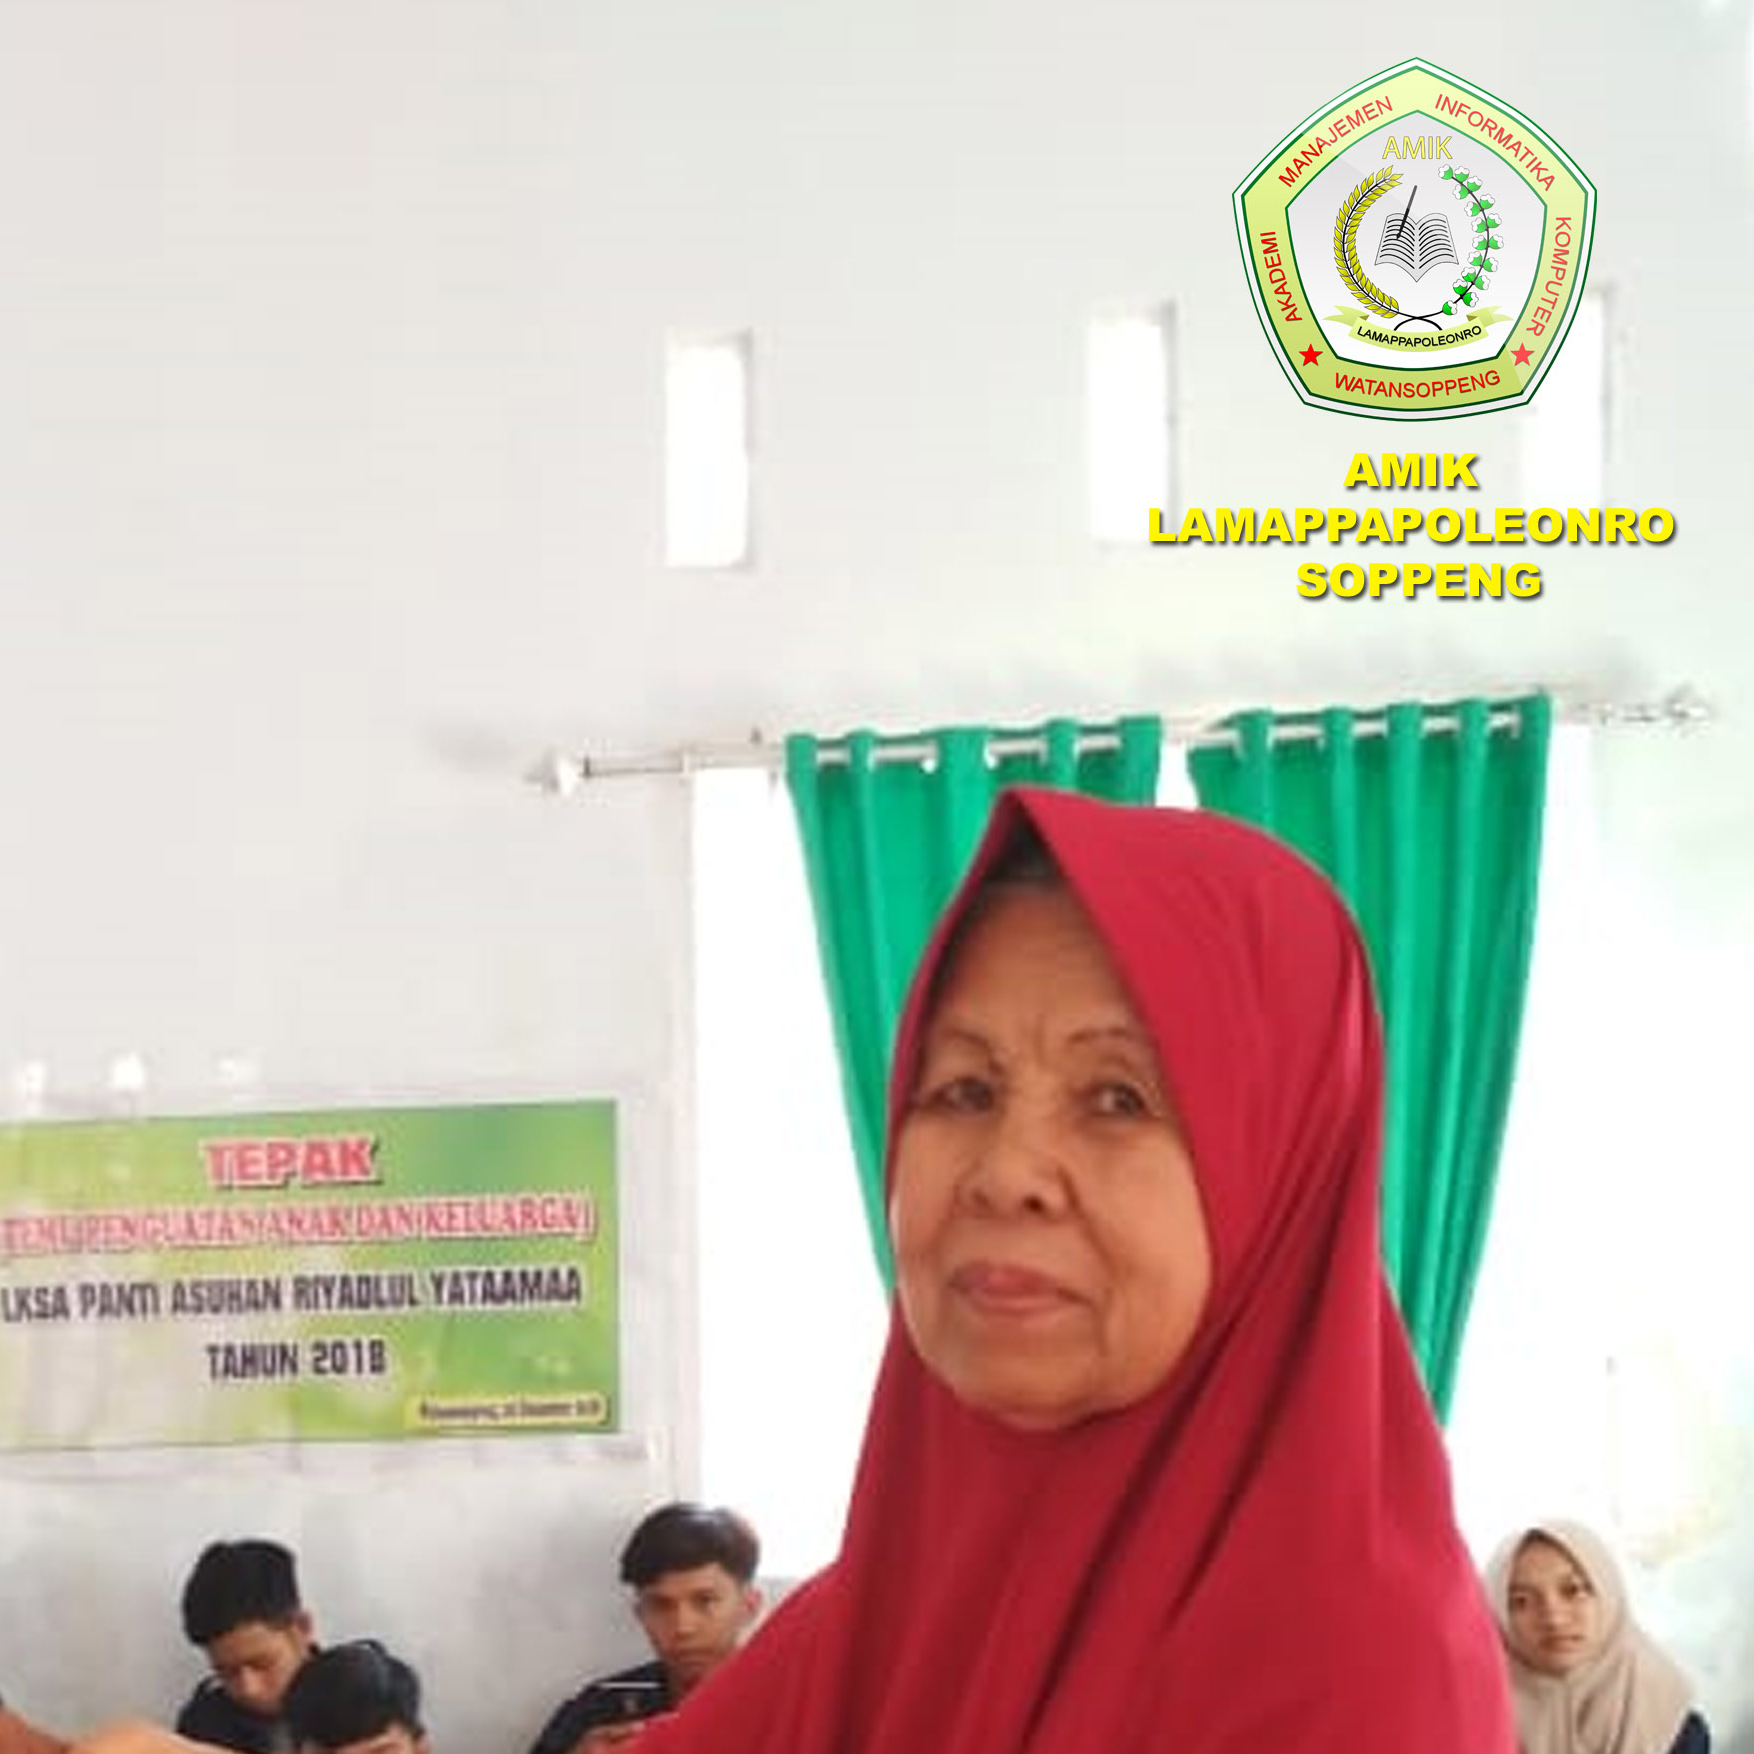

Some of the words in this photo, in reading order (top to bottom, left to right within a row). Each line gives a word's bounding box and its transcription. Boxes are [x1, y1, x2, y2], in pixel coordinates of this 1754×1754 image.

[203, 1138, 378, 1186] TEPAK
[0, 1286, 70, 1323] LKSA
[78, 1281, 160, 1319] PANTI
[171, 1276, 282, 1315] ASUHAN
[292, 1271, 418, 1310] RIYADLUL
[206, 1343, 299, 1380] TAHUN
[311, 1337, 387, 1377] 2018
